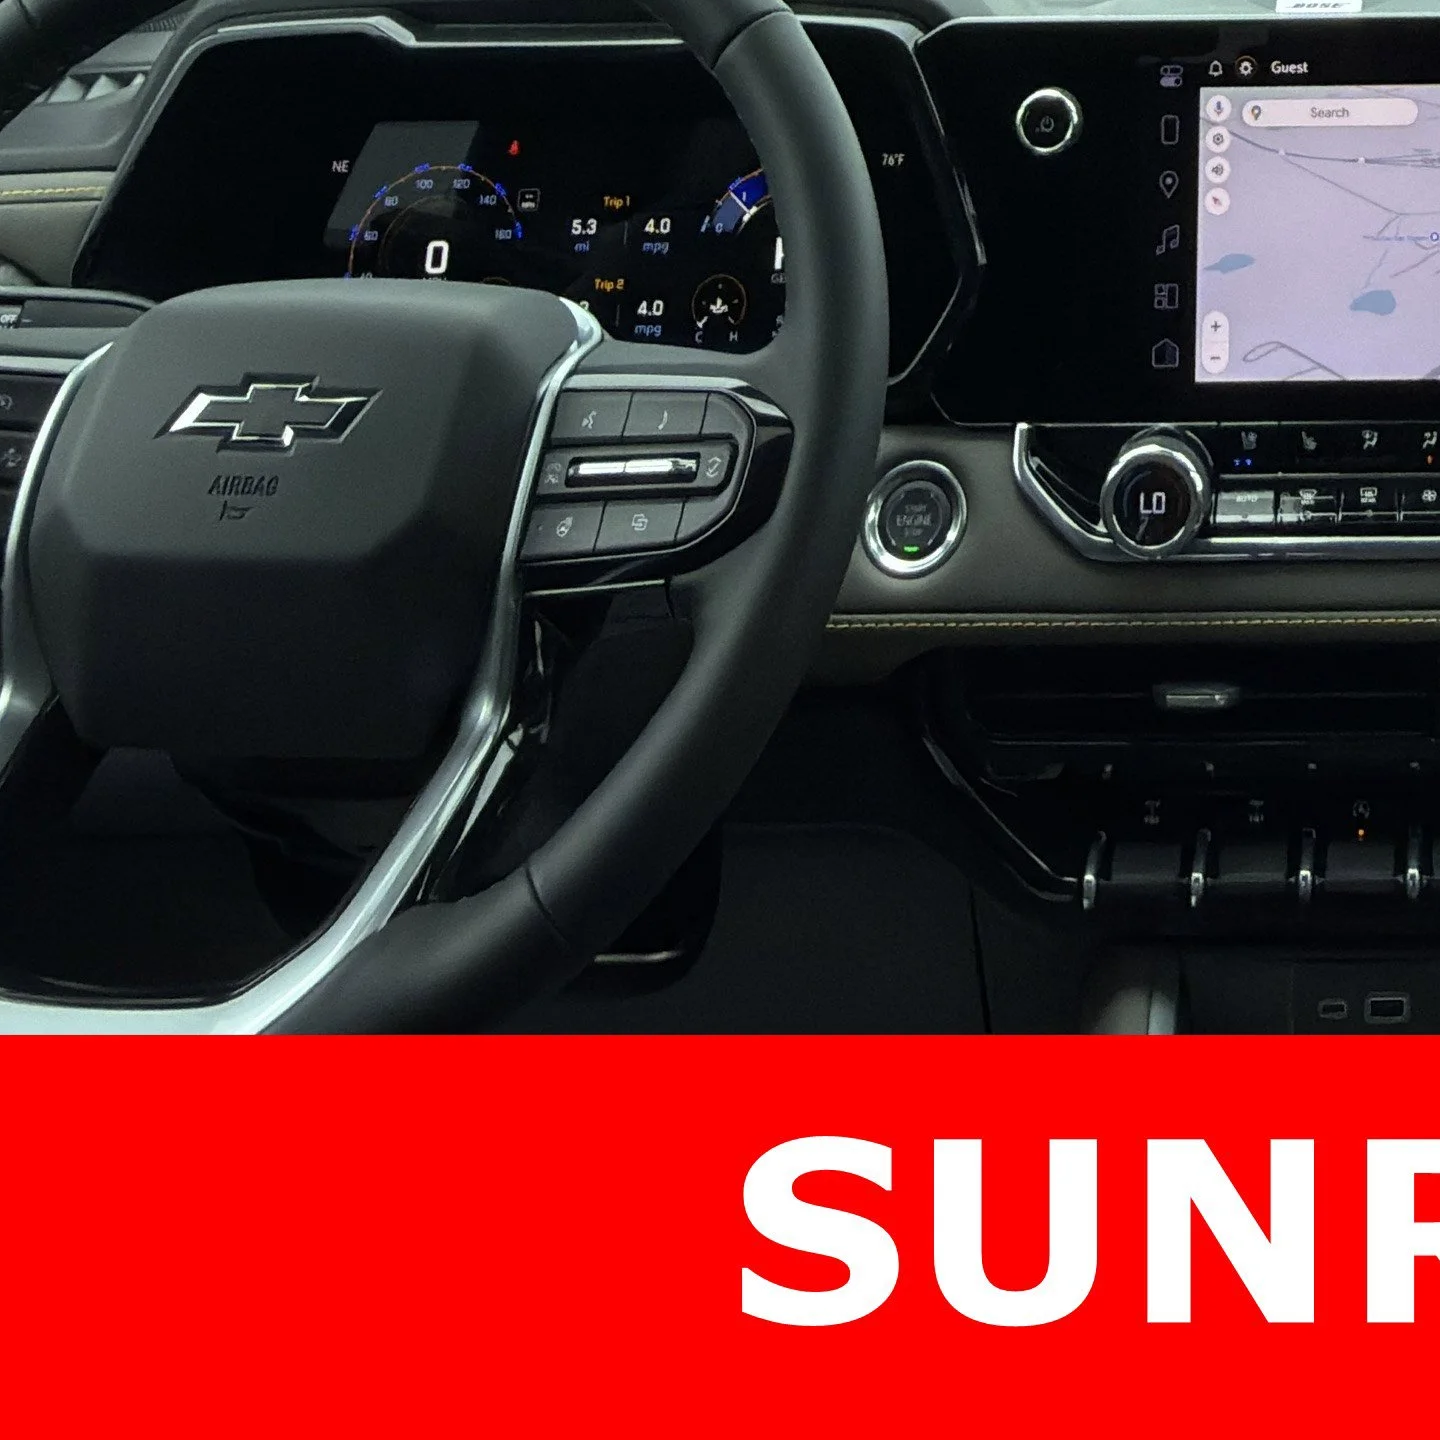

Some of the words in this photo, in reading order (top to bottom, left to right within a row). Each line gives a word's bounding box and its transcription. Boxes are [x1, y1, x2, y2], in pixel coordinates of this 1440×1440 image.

[1271, 60, 1309, 75] Guest
[1310, 106, 1350, 119] Search
[331, 159, 350, 173] NE
[415, 179, 434, 190] 100
[452, 179, 471, 189] 120
[480, 195, 497, 206] 140
[603, 197, 624, 208] Trip
[571, 218, 597, 235] 5.3
[644, 217, 671, 234] 4.0
[574, 241, 590, 252] mi
[642, 241, 670, 254] mpg
[425, 240, 450, 275] 0
[594, 279, 614, 291] Trip
[615, 279, 625, 290] 2
[637, 300, 664, 317] 4.0
[634, 324, 662, 337] mpg
[729, 331, 738, 342] H
[208, 475, 279, 496] AIRBAG
[1140, 492, 1166, 514] LO
